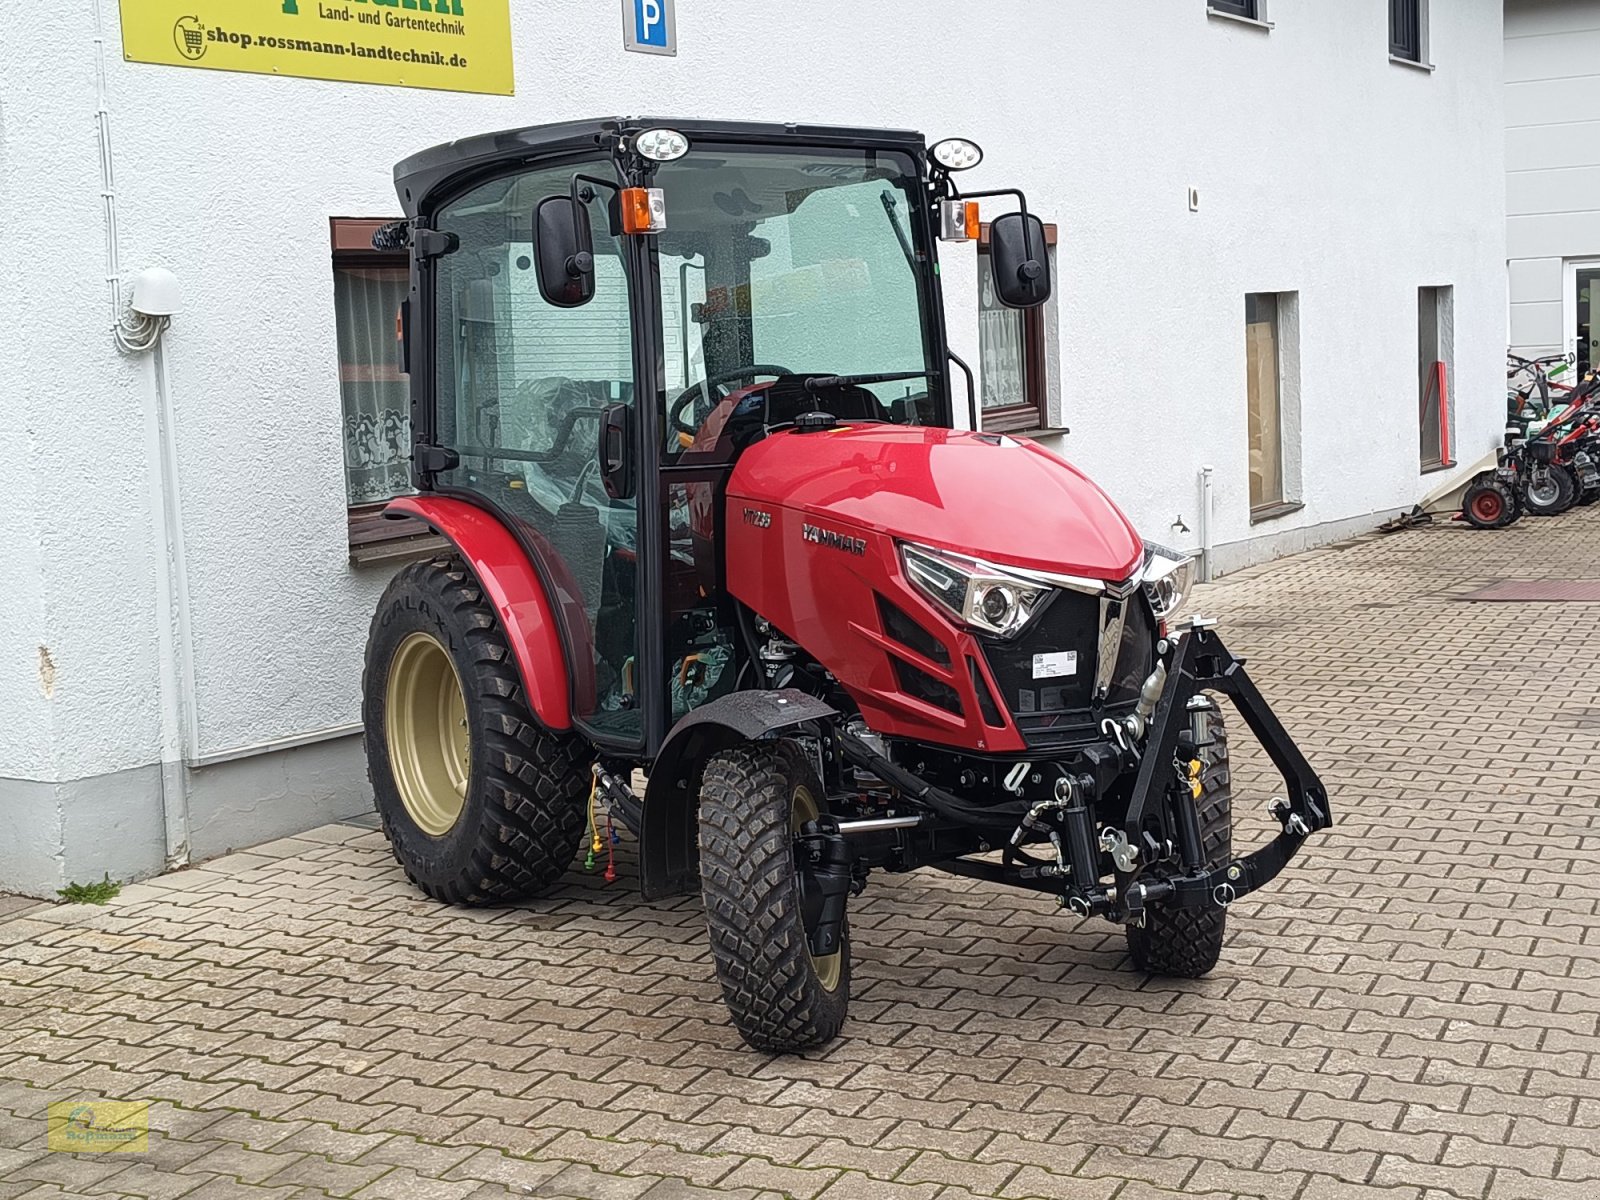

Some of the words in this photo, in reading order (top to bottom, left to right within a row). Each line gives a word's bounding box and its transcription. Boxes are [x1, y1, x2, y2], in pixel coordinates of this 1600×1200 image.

[319, 3, 354, 21] Land-
[358, 10, 380, 25] und
[385, 12, 465, 36] Gartentechnik
[642, 0, 660, 40] P
[206, 26, 467, 67] shop.rossmann-landtechnik.de
[803, 523, 867, 556] YANMAR
[381, 595, 459, 652] GALAXY
